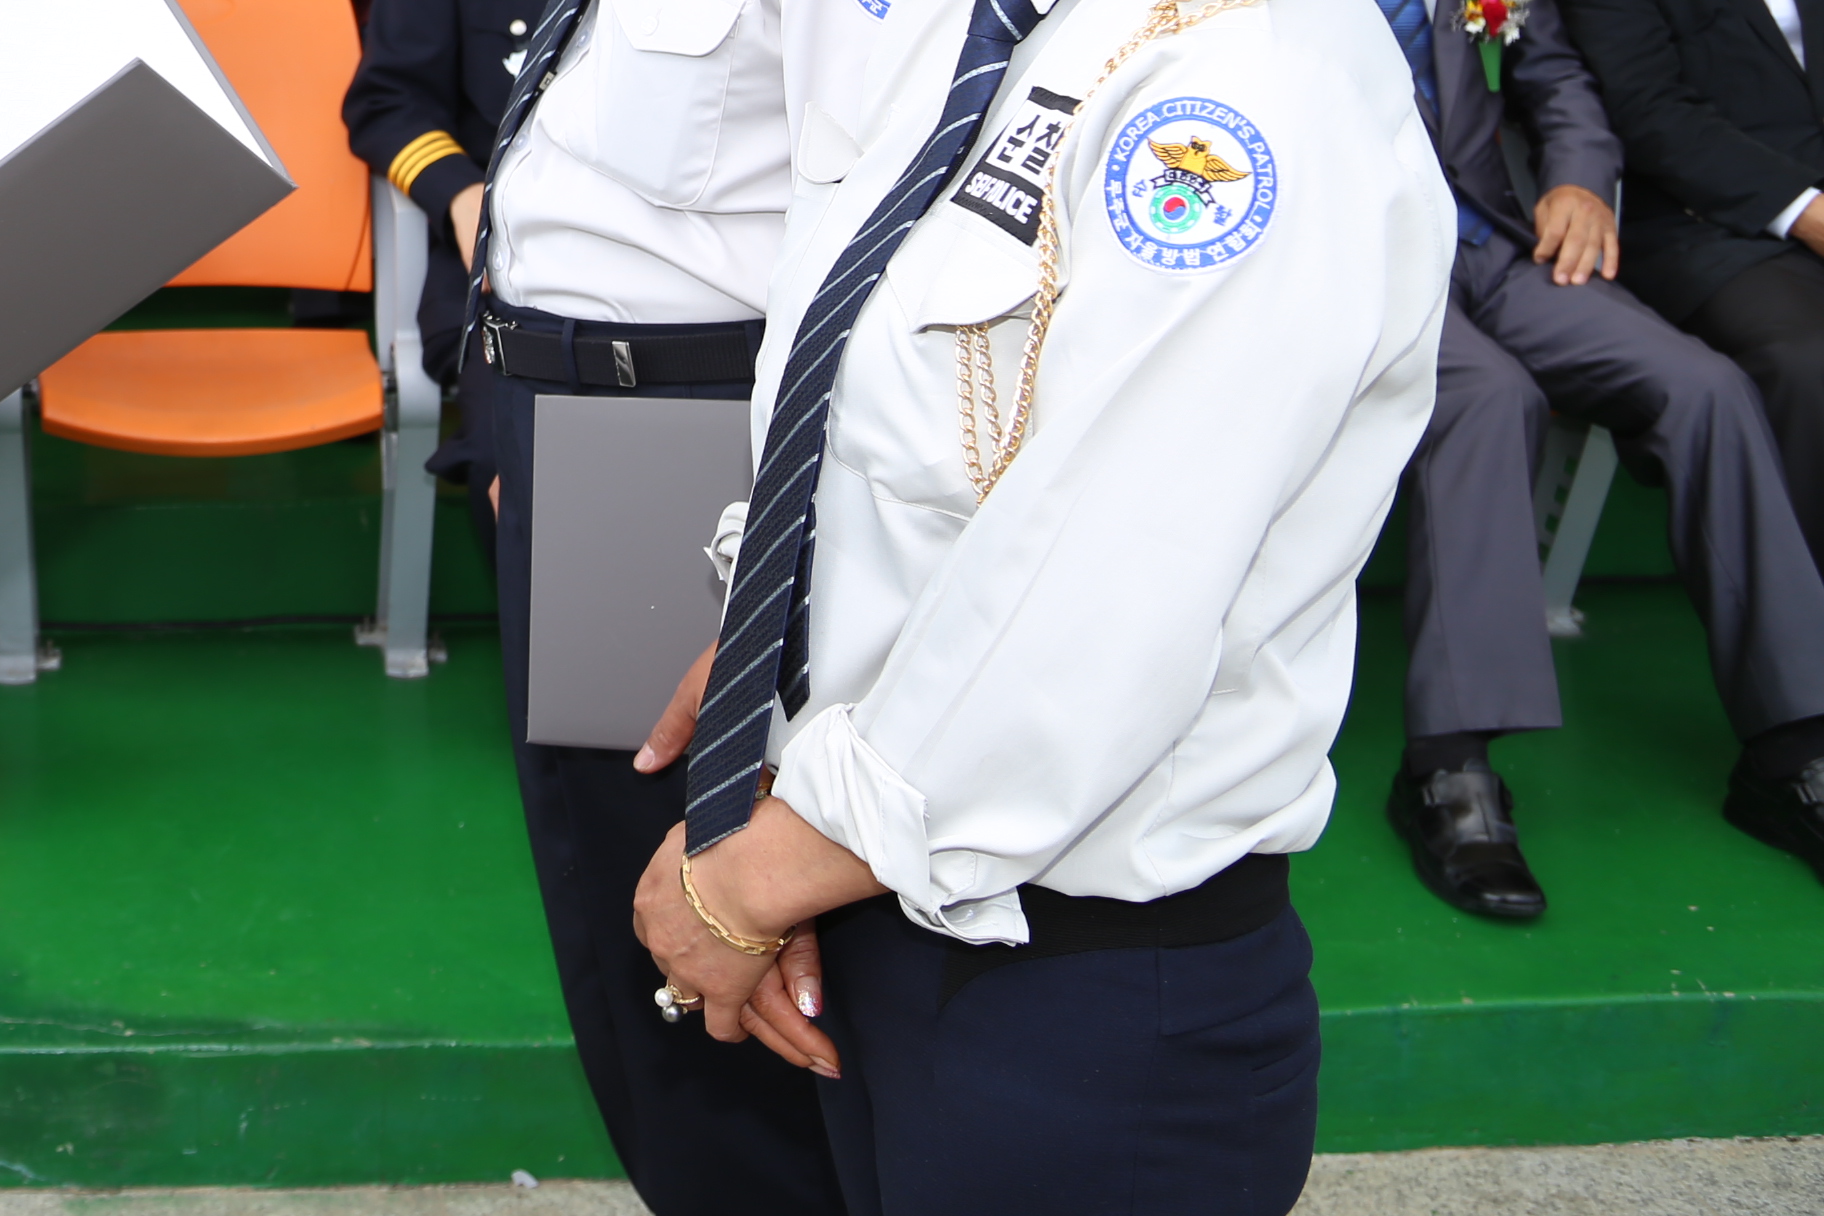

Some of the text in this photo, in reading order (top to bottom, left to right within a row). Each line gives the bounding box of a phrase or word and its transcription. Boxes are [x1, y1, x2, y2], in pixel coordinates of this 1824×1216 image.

[996, 114, 1066, 176] 순찰
[1114, 111, 1161, 162] KOREA
[1162, 100, 1255, 140] CITIZEN'S
[1248, 141, 1274, 211] PATROL
